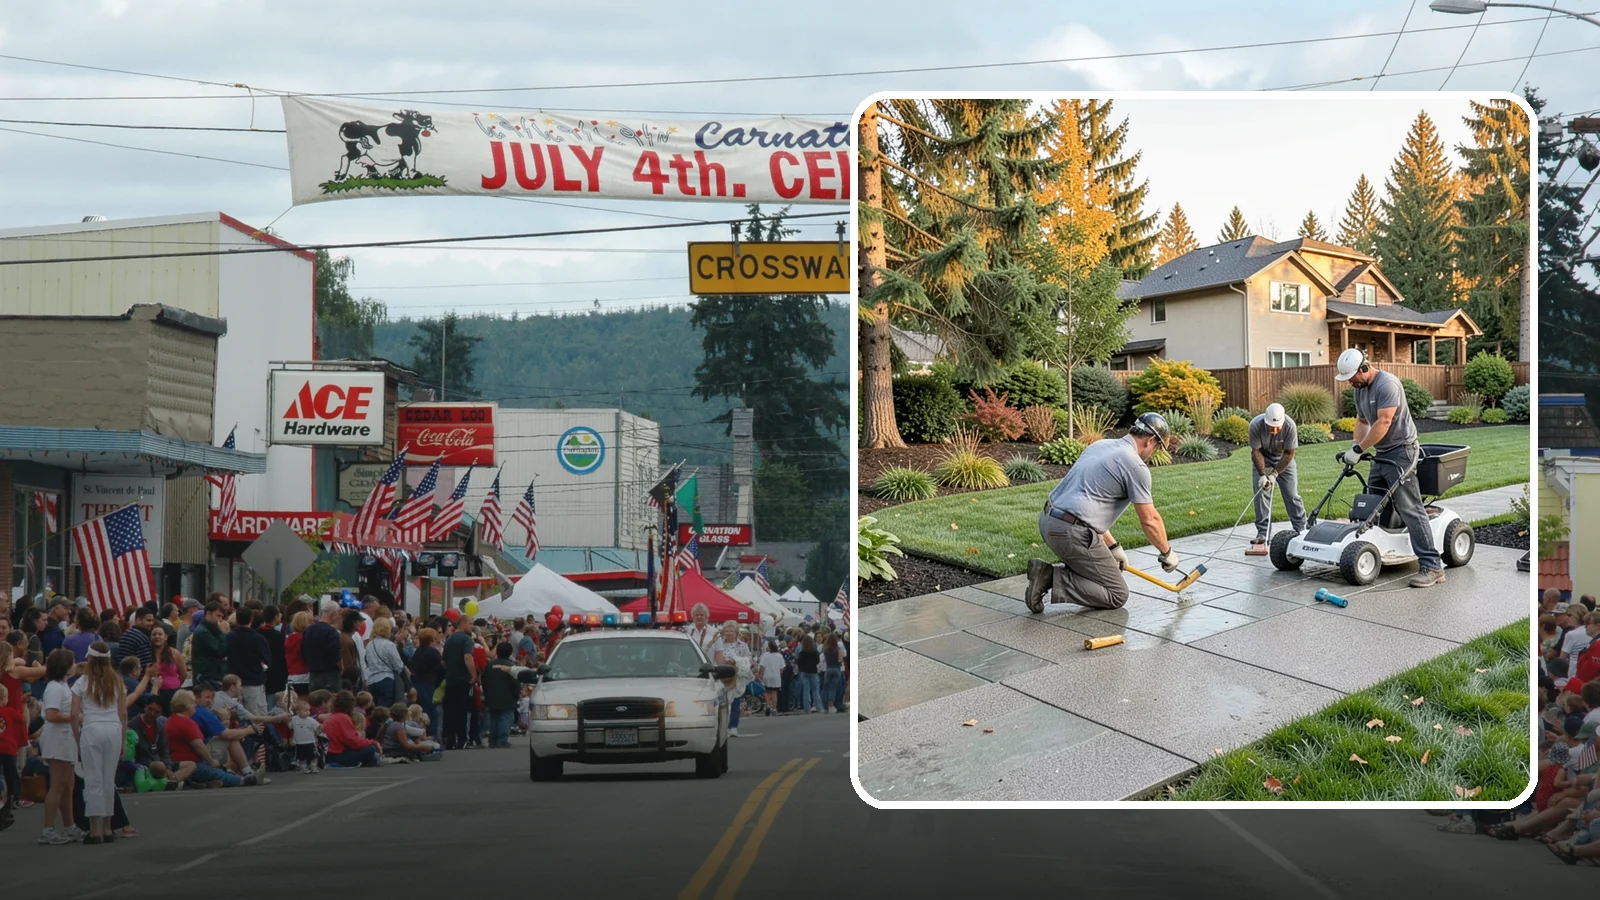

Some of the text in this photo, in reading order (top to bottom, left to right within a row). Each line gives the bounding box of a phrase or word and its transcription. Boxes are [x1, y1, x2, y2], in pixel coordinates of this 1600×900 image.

[481, 140, 604, 193] JULY
[632, 150, 746, 198] 4th.
[697, 254, 850, 280] CROSSWA
[283, 380, 373, 420] ACE
[405, 409, 453, 422] CEDAR
[283, 421, 371, 437] Hardware
[416, 428, 477, 447] Coca-Cola
[95, 485, 124, 495] Vincent
[126, 486, 136, 495] de
[138, 486, 155, 496] Paul
[212, 516, 331, 536] HARDARE
[688, 526, 741, 535] CRNATION
[699, 535, 730, 543] GLASS
